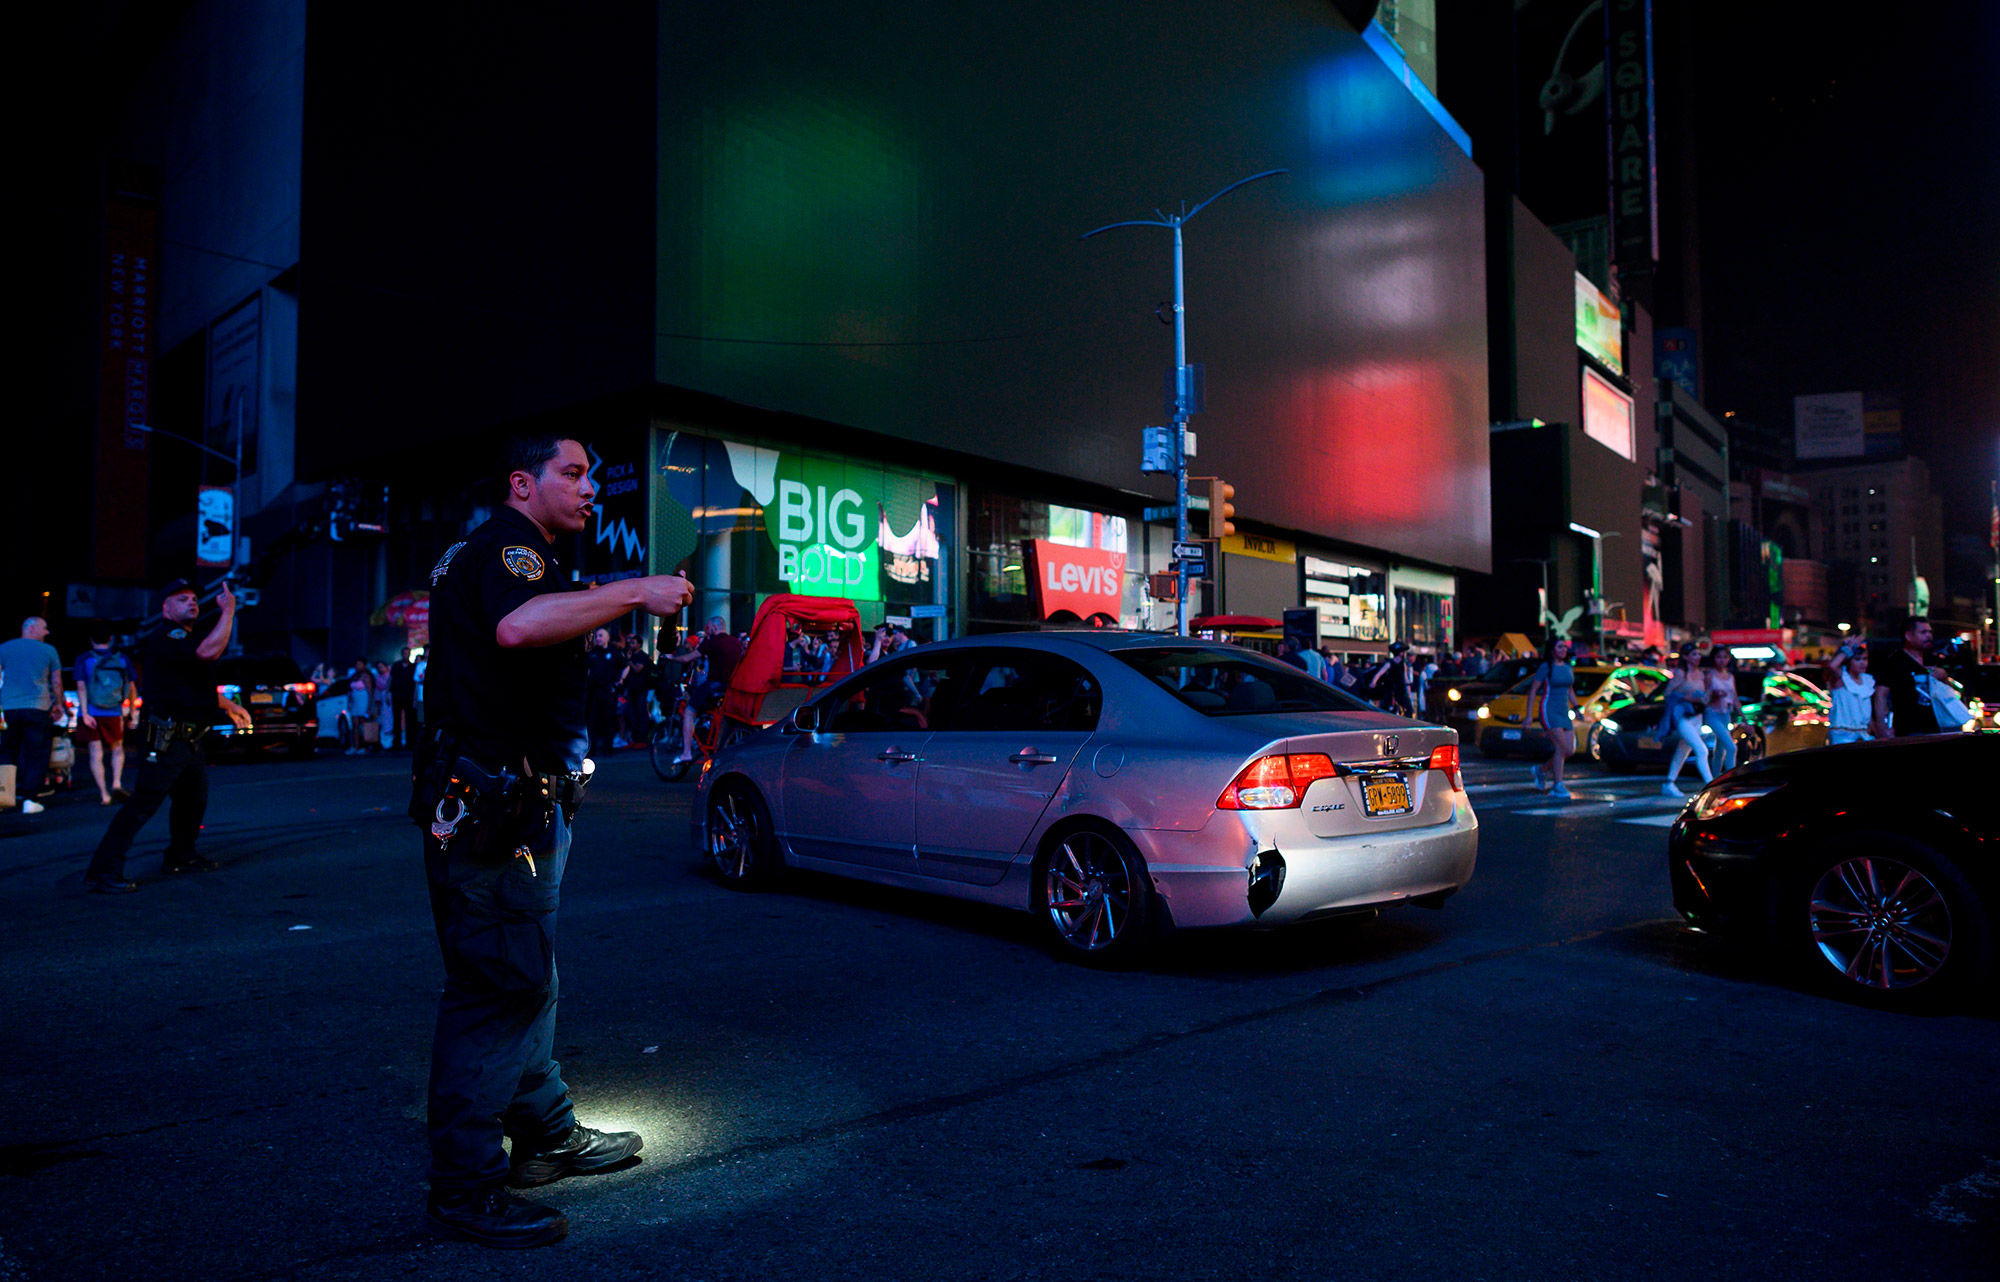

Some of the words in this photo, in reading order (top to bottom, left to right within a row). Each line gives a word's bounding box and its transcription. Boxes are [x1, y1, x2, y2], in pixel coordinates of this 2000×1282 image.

[1614, 29, 1644, 216] SQUARE
[111, 253, 125, 295] NEW
[131, 256, 148, 353] MARRIOTT
[109, 301, 125, 351] YORK
[606, 464, 627, 480] PICK
[627, 461, 635, 476] A
[606, 478, 639, 497] DESIGN
[779, 479, 865, 549] BIG
[778, 543, 864, 586] BOLD
[1244, 535, 1276, 554] INVICTA
[1311, 803, 1345, 812] CIVIC
